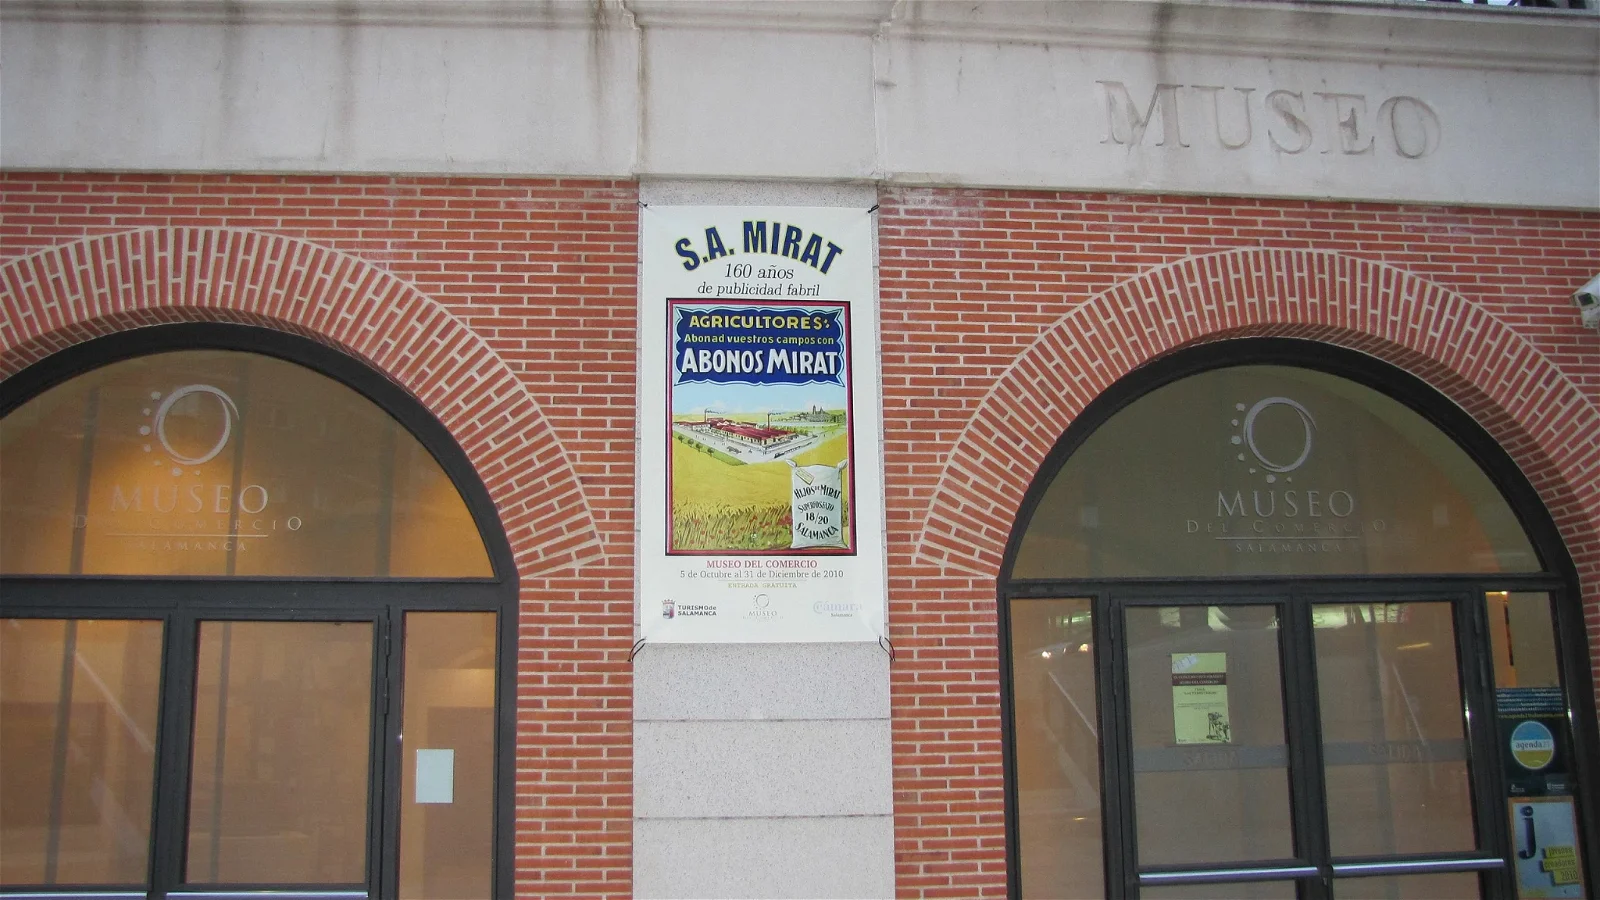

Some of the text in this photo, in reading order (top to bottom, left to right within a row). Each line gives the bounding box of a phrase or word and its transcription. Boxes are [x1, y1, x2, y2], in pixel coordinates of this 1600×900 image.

[1096, 80, 1440, 159] MUSEO
[674, 220, 843, 275] S.A. MIRAT
[724, 263, 794, 279] 160 años
[697, 282, 820, 297] de publicidad fabril
[684, 334, 834, 346] Abonad vuestros campos con
[681, 348, 838, 376] ABONOS MIRAT
[109, 484, 269, 514] MUSEO
[793, 486, 815, 500] HIJOS
[1216, 490, 1355, 518] MUSEO
[806, 512, 829, 524] 18/20
[795, 522, 839, 540] SALAMANCA
[125, 539, 248, 552] ALAMANCA
[1235, 543, 1342, 552] SALAMANCA
[706, 560, 818, 569] MUSEO DEL COMERCIO
[680, 570, 844, 579] 5 de Octubre al 31 de Diciembre de 2010
[1560, 870, 1579, 881] 2010
